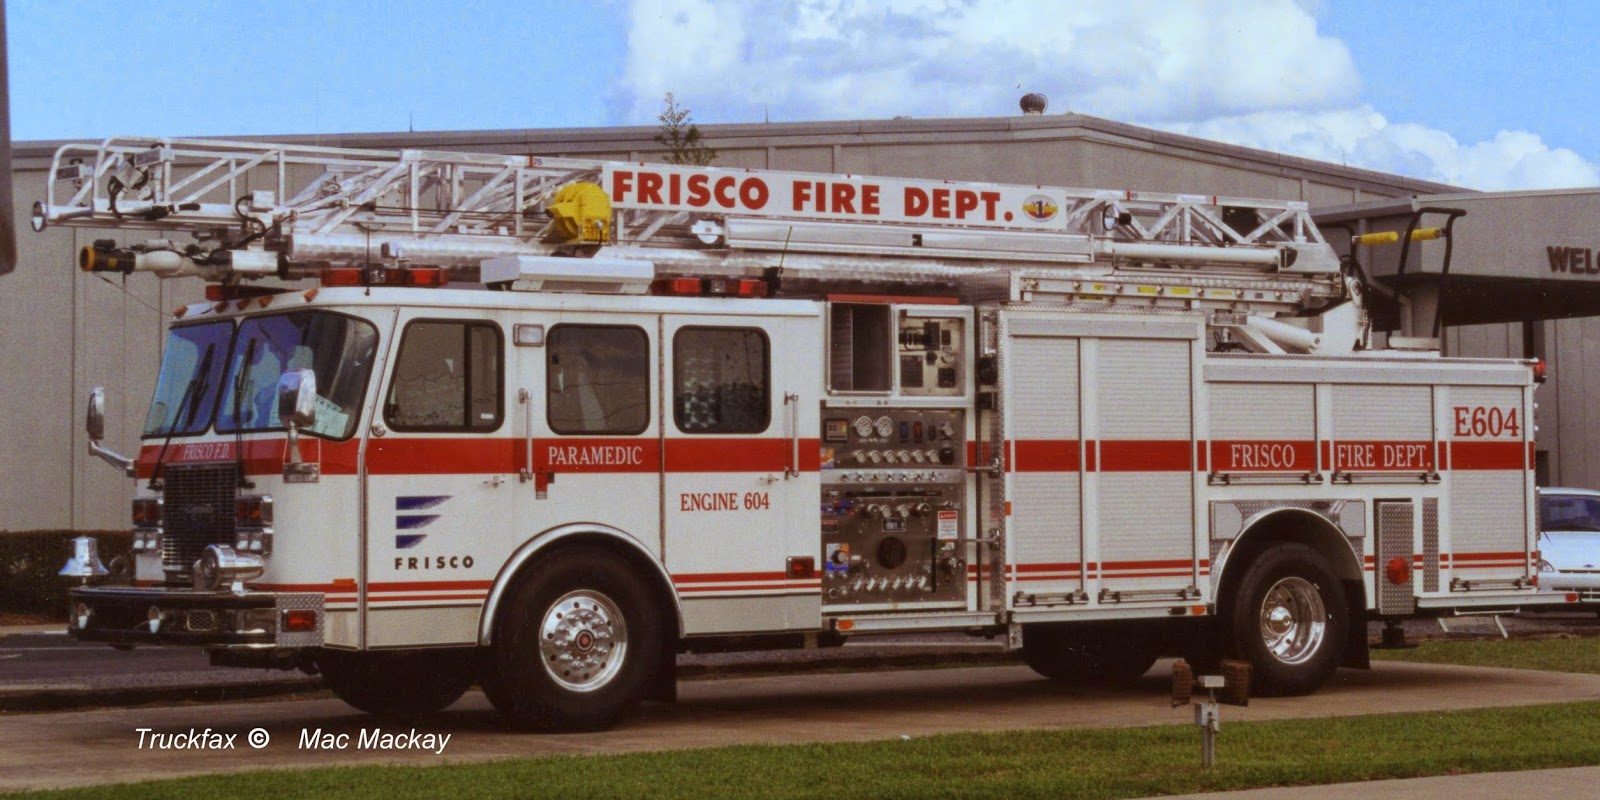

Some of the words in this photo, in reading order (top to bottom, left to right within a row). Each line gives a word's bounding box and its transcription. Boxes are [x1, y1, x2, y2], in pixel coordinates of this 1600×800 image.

[612, 170, 769, 210] FRISCO
[792, 180, 881, 215] FIRE
[904, 186, 1014, 222] DEPT.
[1546, 245, 1600, 275] WEL
[1453, 406, 1519, 437] E604
[183, 444, 213, 460] FRISCO
[548, 446, 643, 465] PARAMEDIC
[1231, 444, 1295, 468] FRISCO
[1337, 444, 1375, 468] FIRE
[1383, 444, 1431, 468] DEPT.
[680, 492, 738, 512] ENGINE
[743, 492, 770, 510] 604
[394, 555, 474, 570] FRISCO
